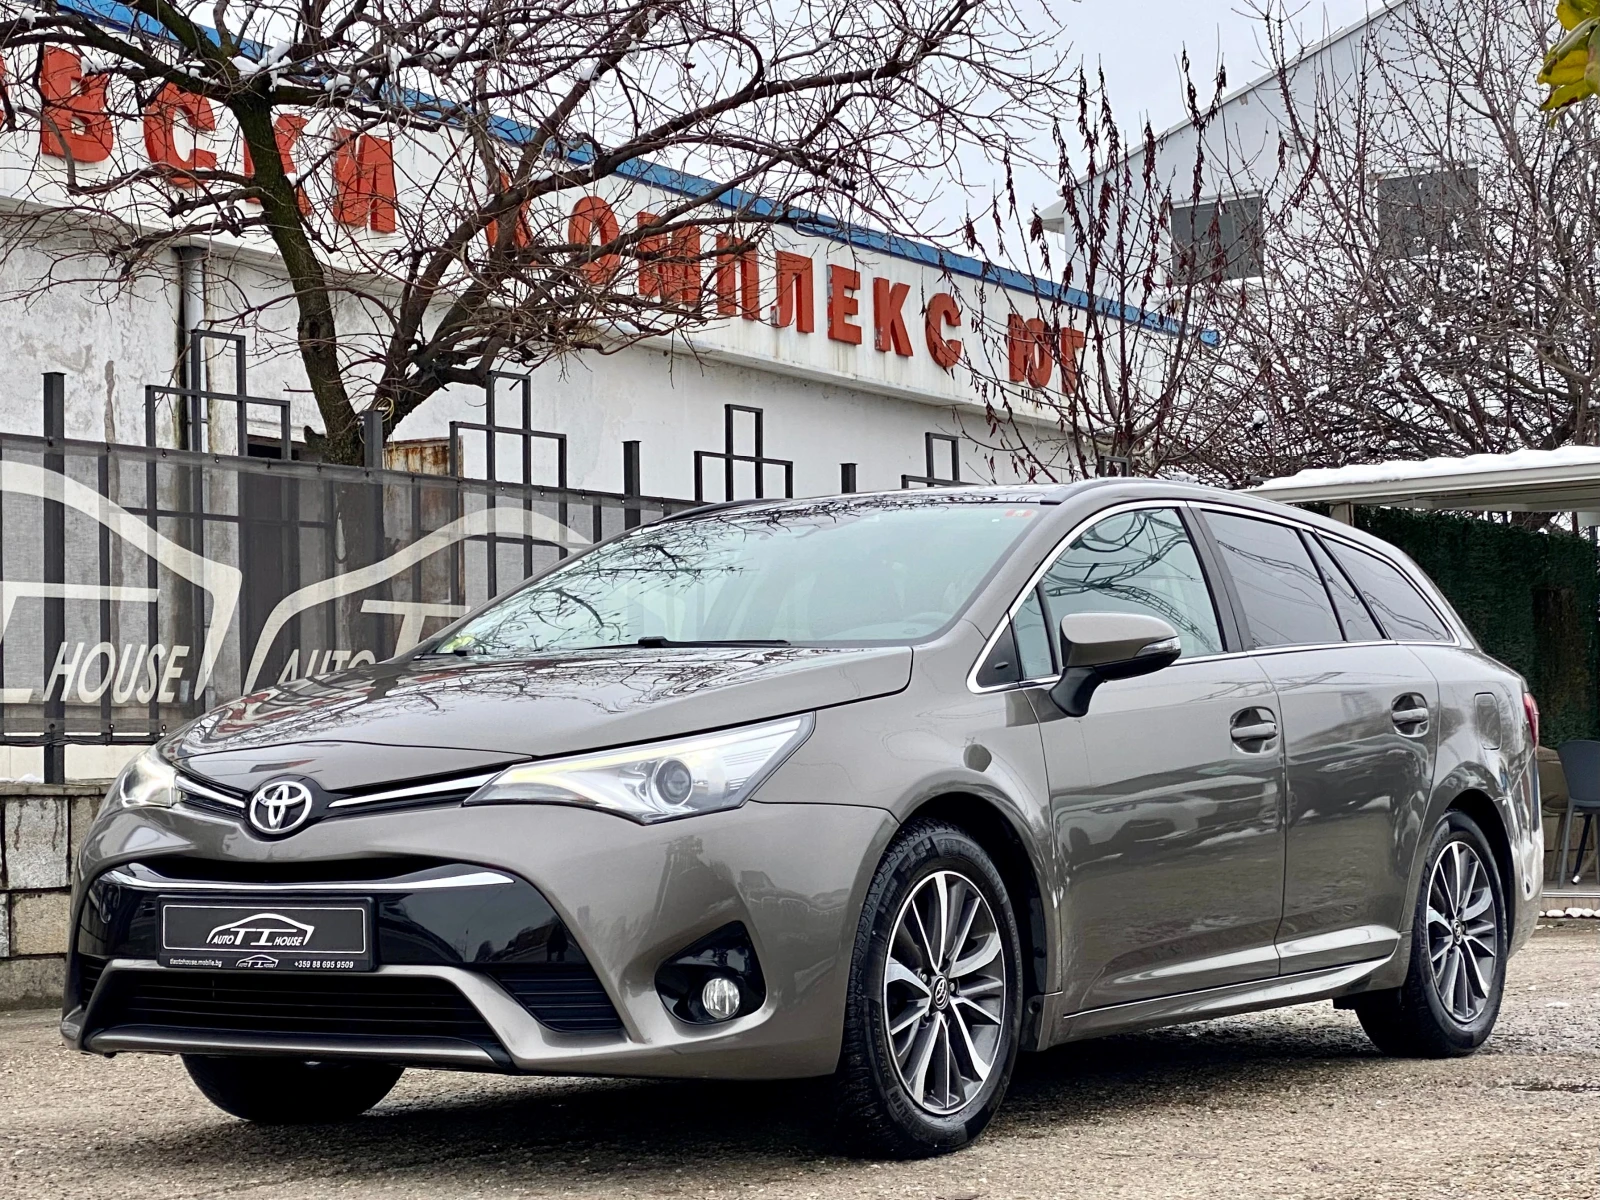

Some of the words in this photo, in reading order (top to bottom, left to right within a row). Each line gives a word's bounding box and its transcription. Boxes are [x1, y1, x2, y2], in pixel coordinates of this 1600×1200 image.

[0, 46, 396, 234] ВСКИ
[1007, 313, 1085, 394] ЮГ
[42, 641, 190, 703] HOUSE
[211, 935, 234, 945] AUTO
[273, 936, 303, 946] HOUSE
[294, 960, 311, 968] +359
[312, 960, 320, 968] 88
[336, 961, 354, 969] 9509
